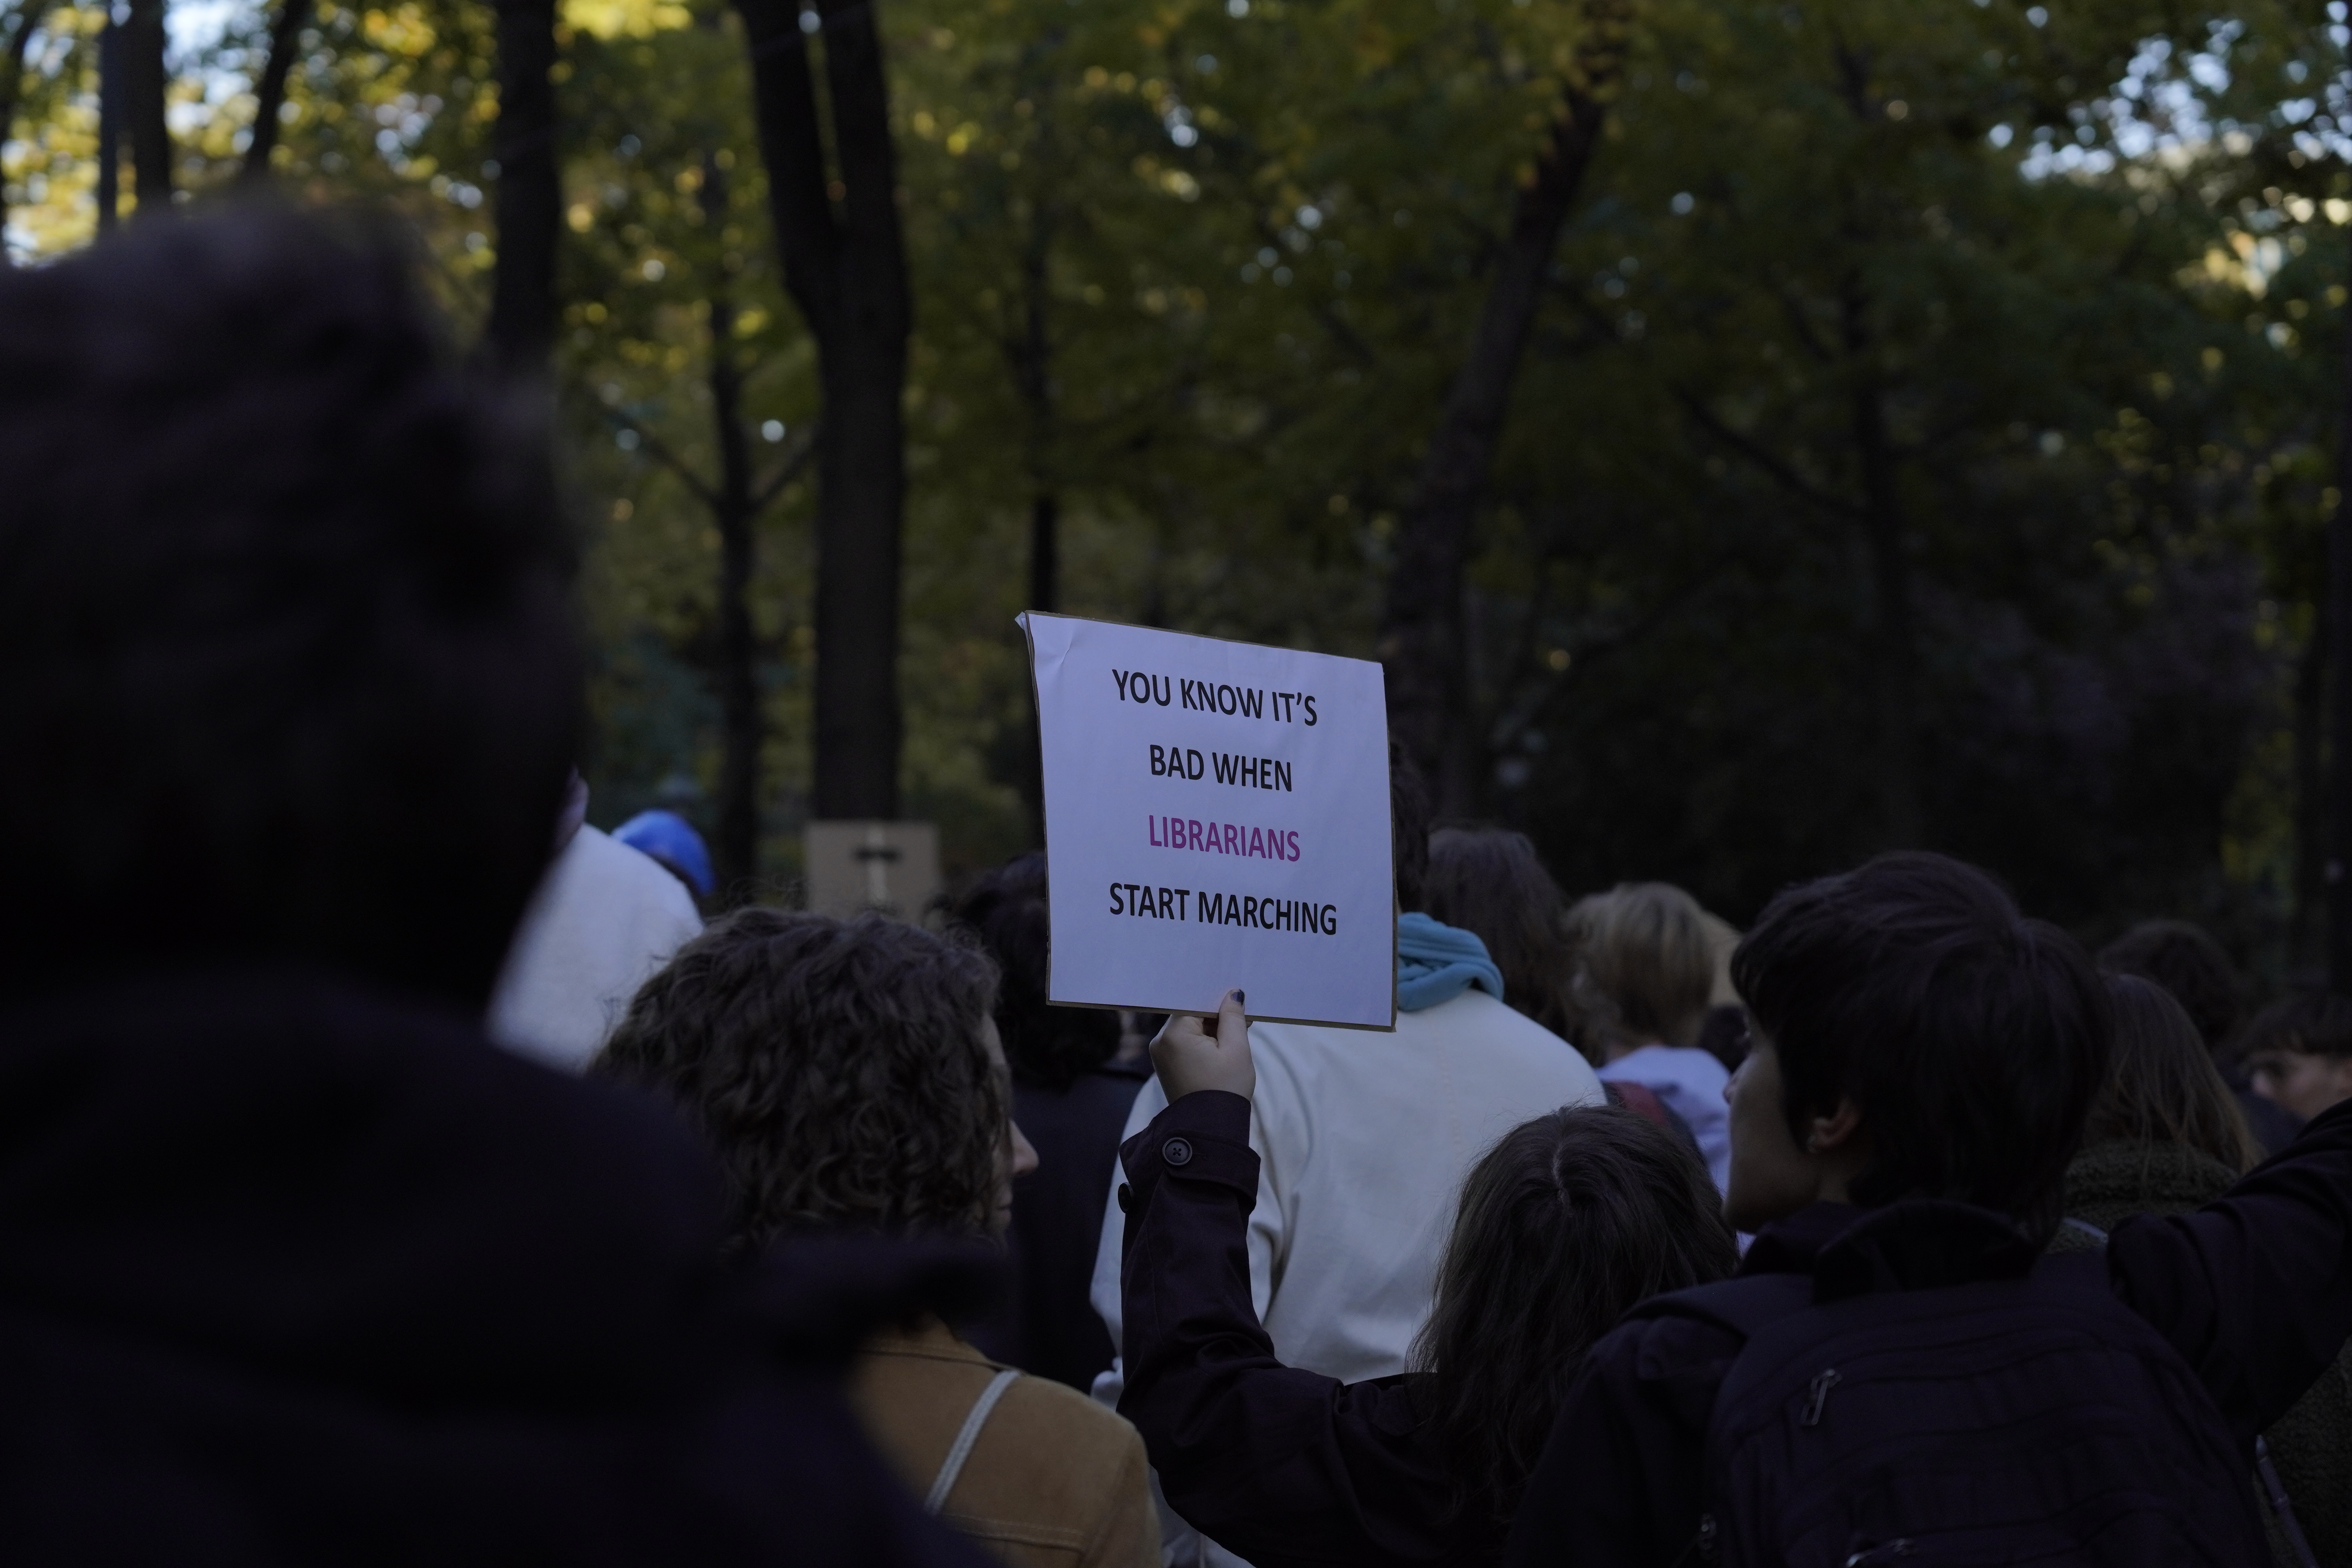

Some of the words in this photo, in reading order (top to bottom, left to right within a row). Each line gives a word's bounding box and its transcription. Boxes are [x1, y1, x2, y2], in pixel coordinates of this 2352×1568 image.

[1112, 669, 1171, 706] YOU
[1180, 678, 1263, 719] KNOW
[1272, 691, 1317, 726] IT’S
[1150, 744, 1204, 780] BAD
[1212, 752, 1292, 792] WHEN
[1149, 815, 1300, 862] LIBRARIANS
[1110, 882, 1190, 921] START
[1198, 891, 1336, 936] MARCHING
